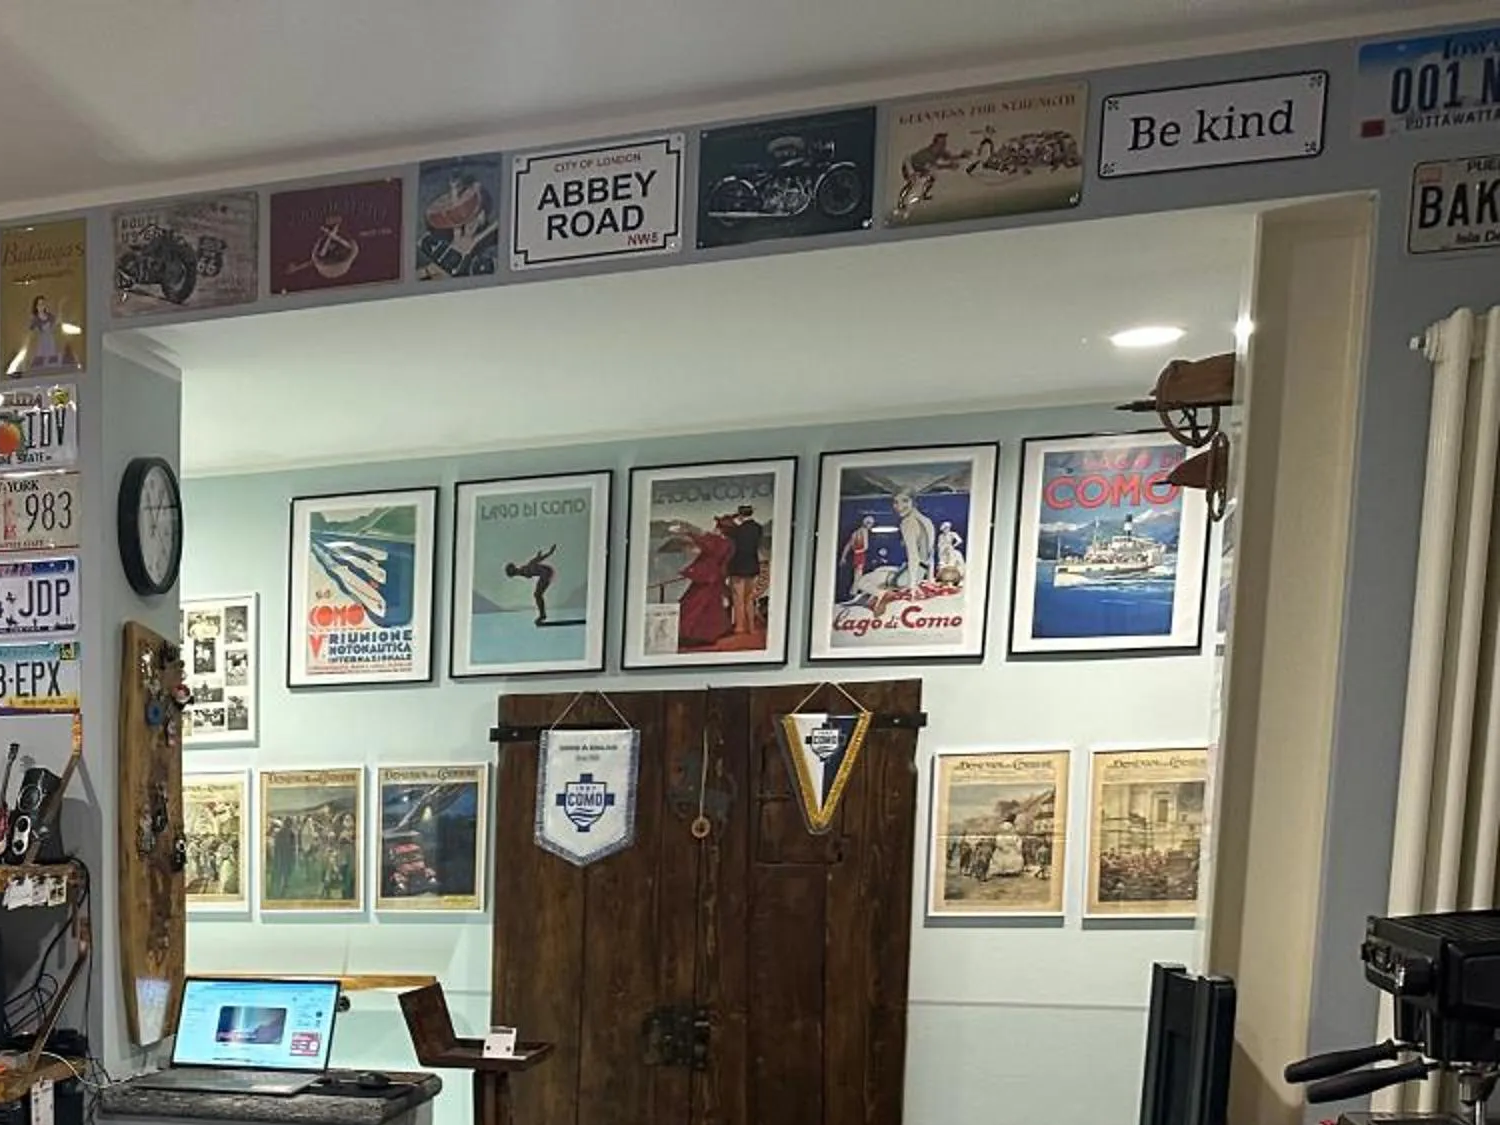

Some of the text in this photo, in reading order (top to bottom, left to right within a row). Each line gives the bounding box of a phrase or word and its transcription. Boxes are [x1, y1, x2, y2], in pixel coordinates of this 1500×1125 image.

[1391, 60, 1463, 116] 001
[1127, 99, 1295, 152] Be kind
[553, 151, 642, 174] CITY OF LONDON
[537, 169, 658, 211] ABBEY
[546, 204, 645, 241] ROAD
[6, 479, 39, 493] YORK
[1045, 470, 1180, 511] COMO
[25, 491, 71, 533] 983
[18, 578, 71, 617] JDP
[309, 603, 365, 627] COMO
[833, 607, 882, 637] Lago
[900, 605, 963, 630] Como
[328, 629, 413, 644] RIUNIONE
[328, 643, 412, 656] MOTONAUTICA
[567, 792, 604, 807] COMO
